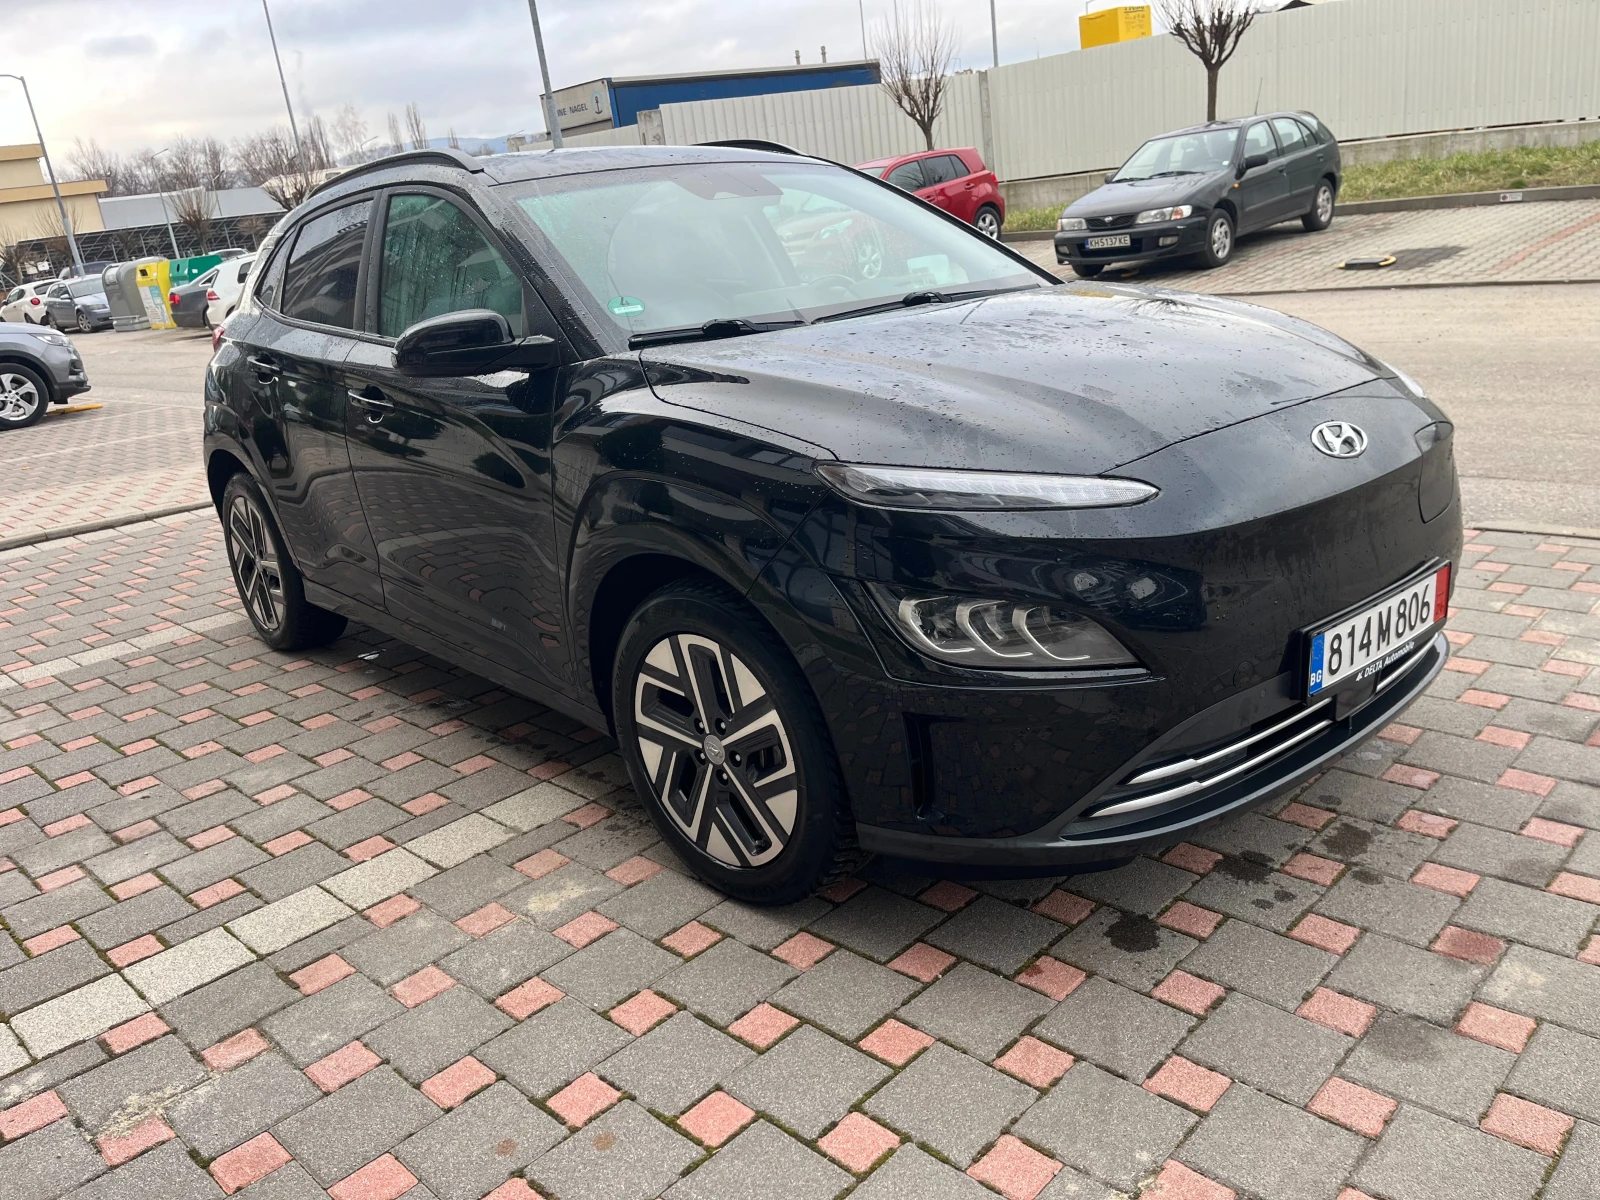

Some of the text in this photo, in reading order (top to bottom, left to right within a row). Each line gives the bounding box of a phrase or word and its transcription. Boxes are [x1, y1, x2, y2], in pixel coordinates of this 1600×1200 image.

[569, 103, 588, 114] NAGEL
[1328, 583, 1431, 676] 814M806
[1364, 659, 1383, 678] DELTA
[1310, 670, 1323, 686] BG
